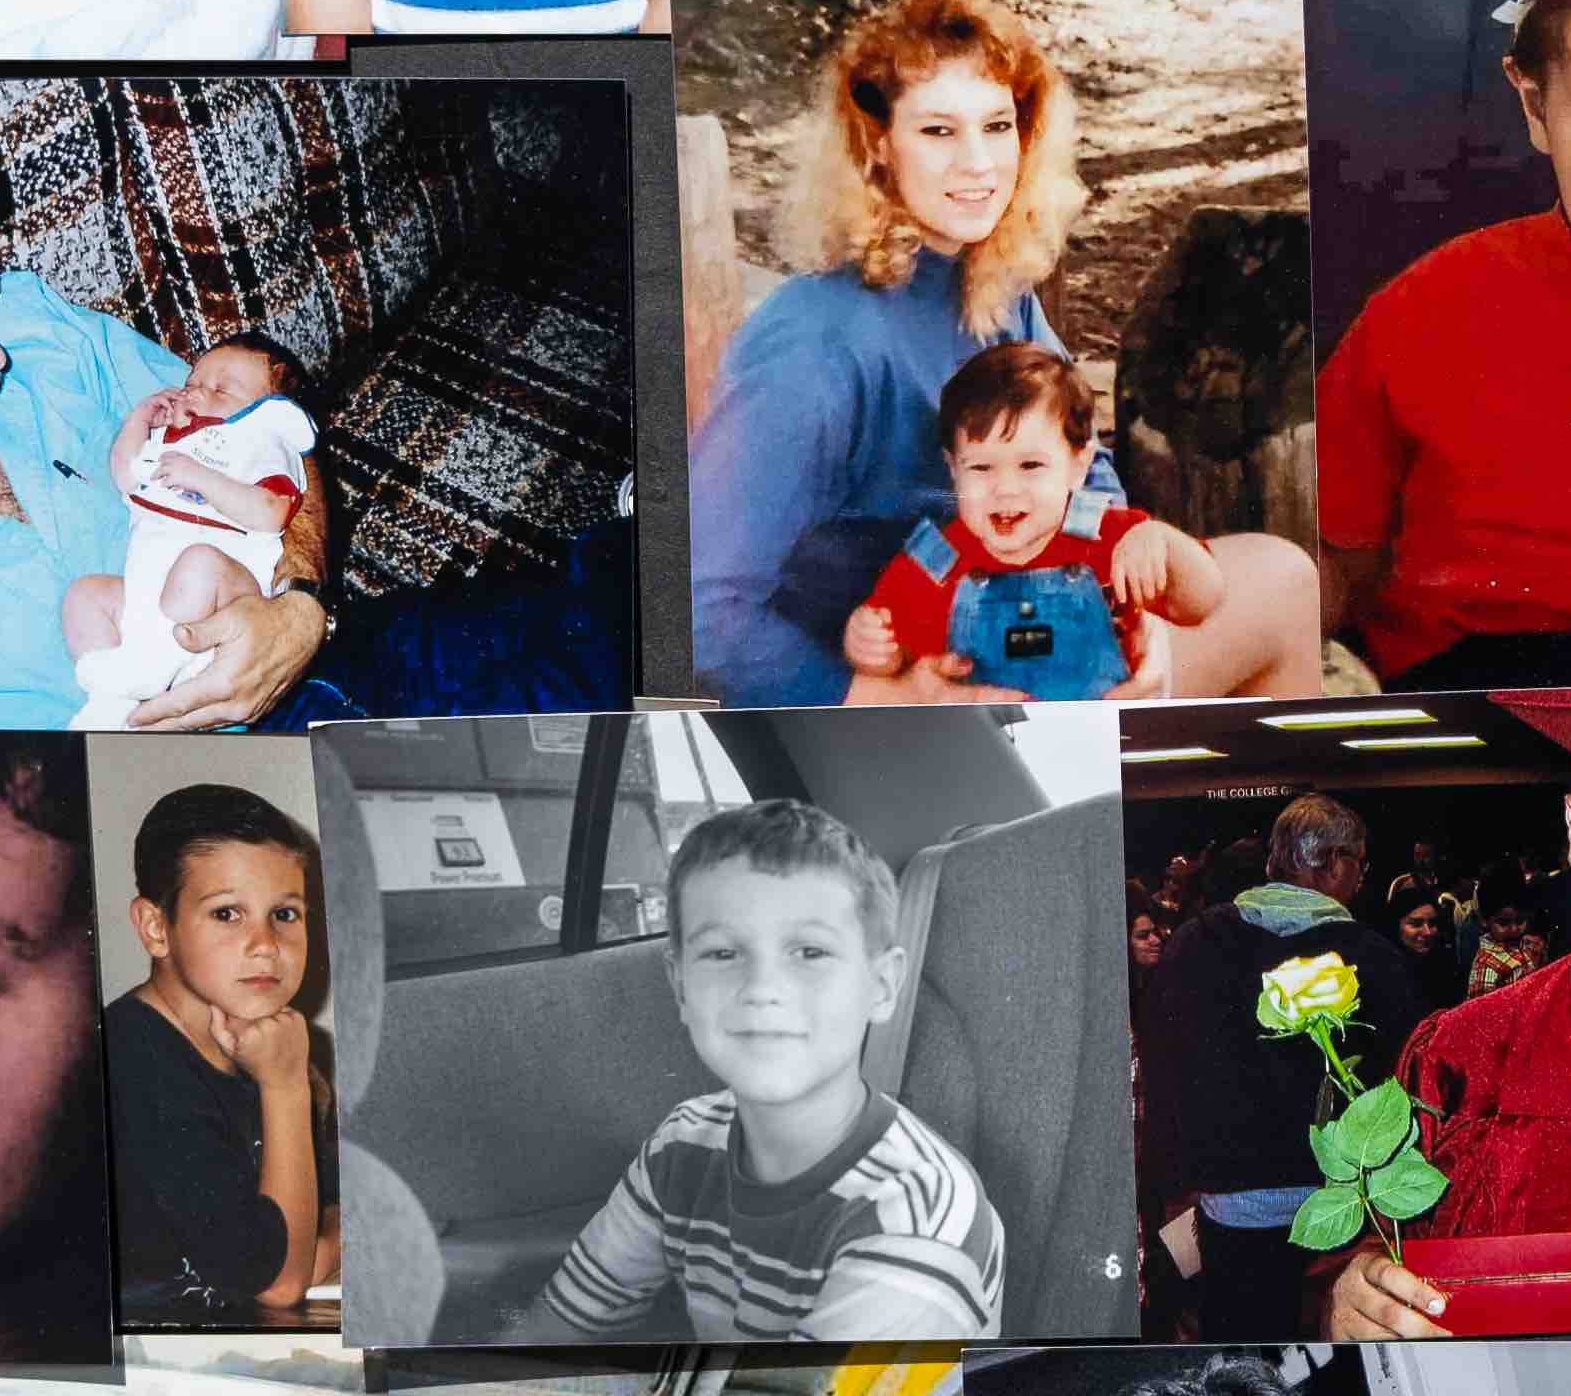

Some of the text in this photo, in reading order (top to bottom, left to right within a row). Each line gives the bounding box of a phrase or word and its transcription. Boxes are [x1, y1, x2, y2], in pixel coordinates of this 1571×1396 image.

[1206, 788, 1227, 800] THE
[1229, 787, 1278, 798] COLLEGE
[1105, 1253, 1122, 1279] 6
